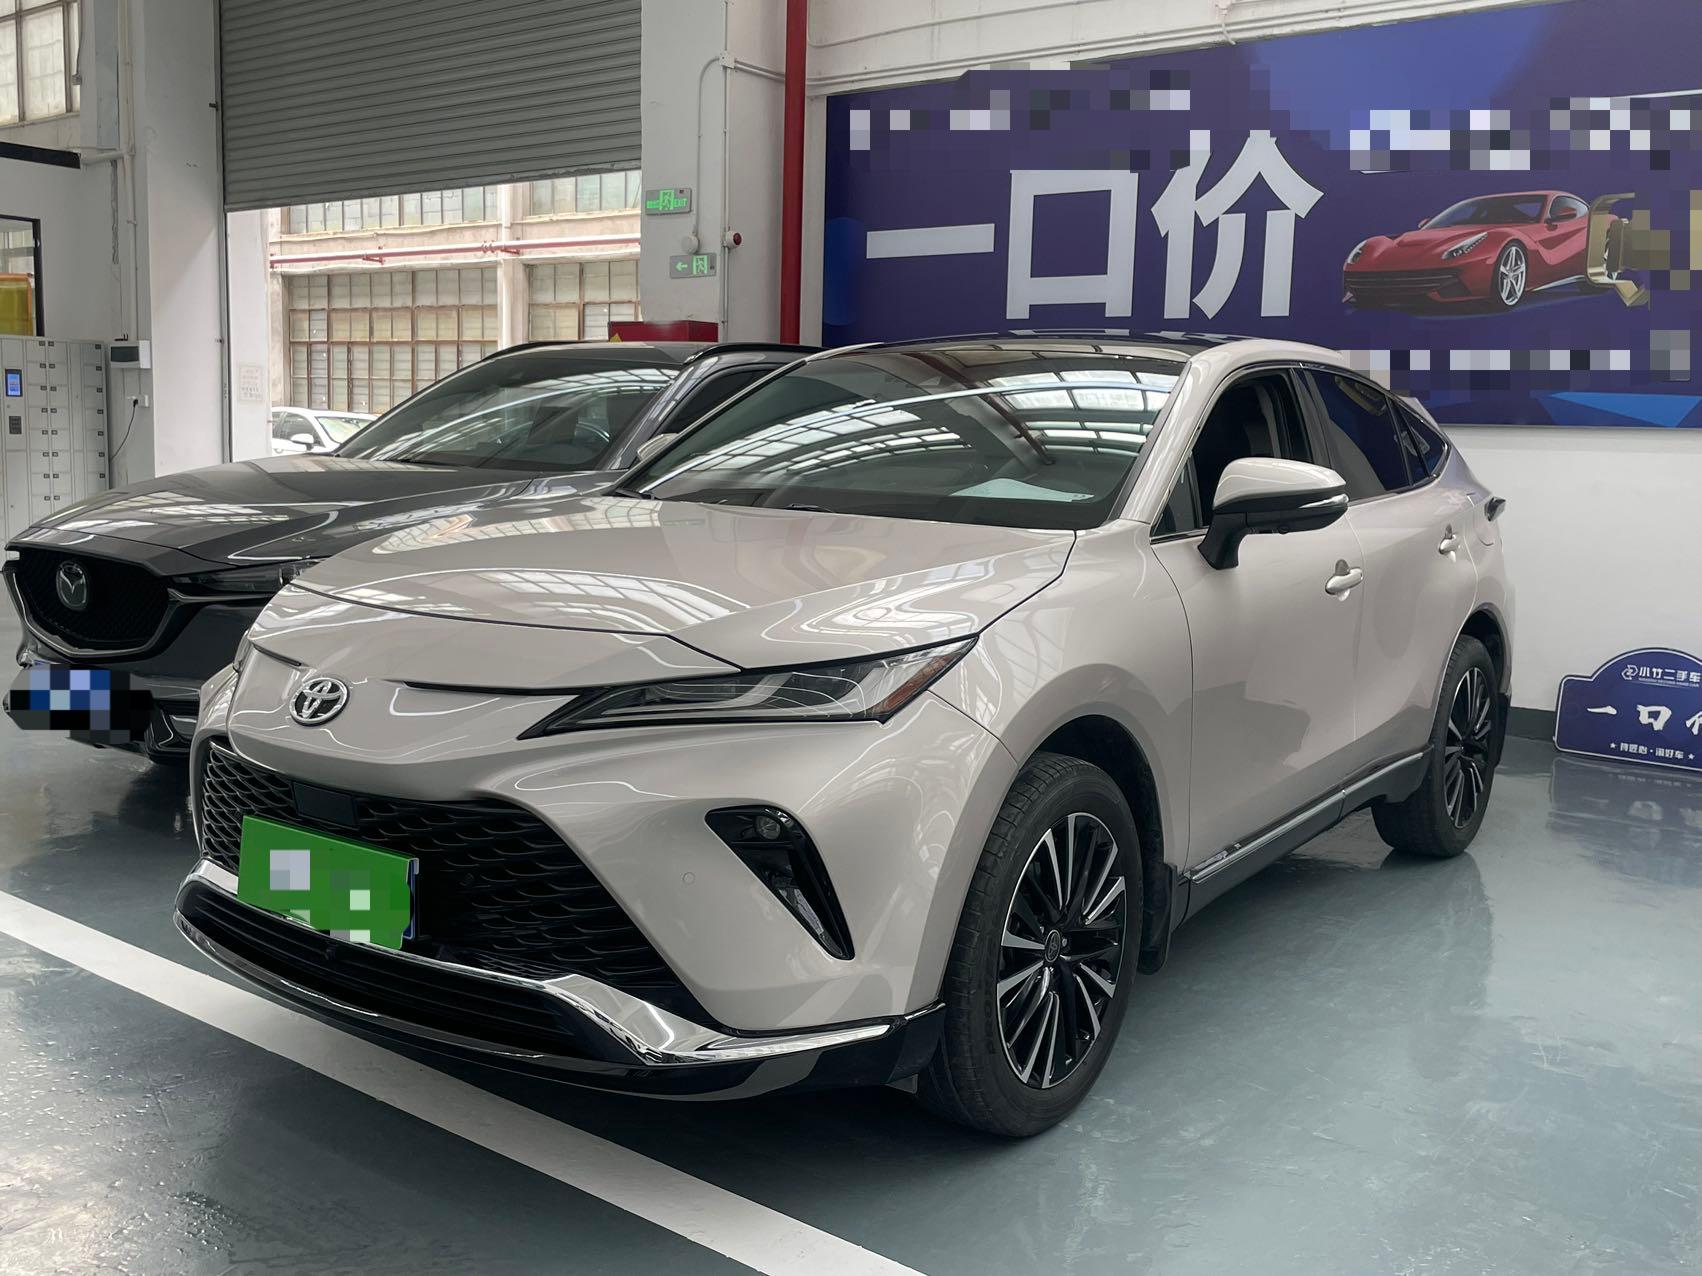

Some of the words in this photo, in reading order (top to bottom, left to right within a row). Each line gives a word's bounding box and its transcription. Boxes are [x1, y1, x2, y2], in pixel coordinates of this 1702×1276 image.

[866, 130, 1324, 319] 一口价
[1639, 667, 1701, 683] 小竹二手车
